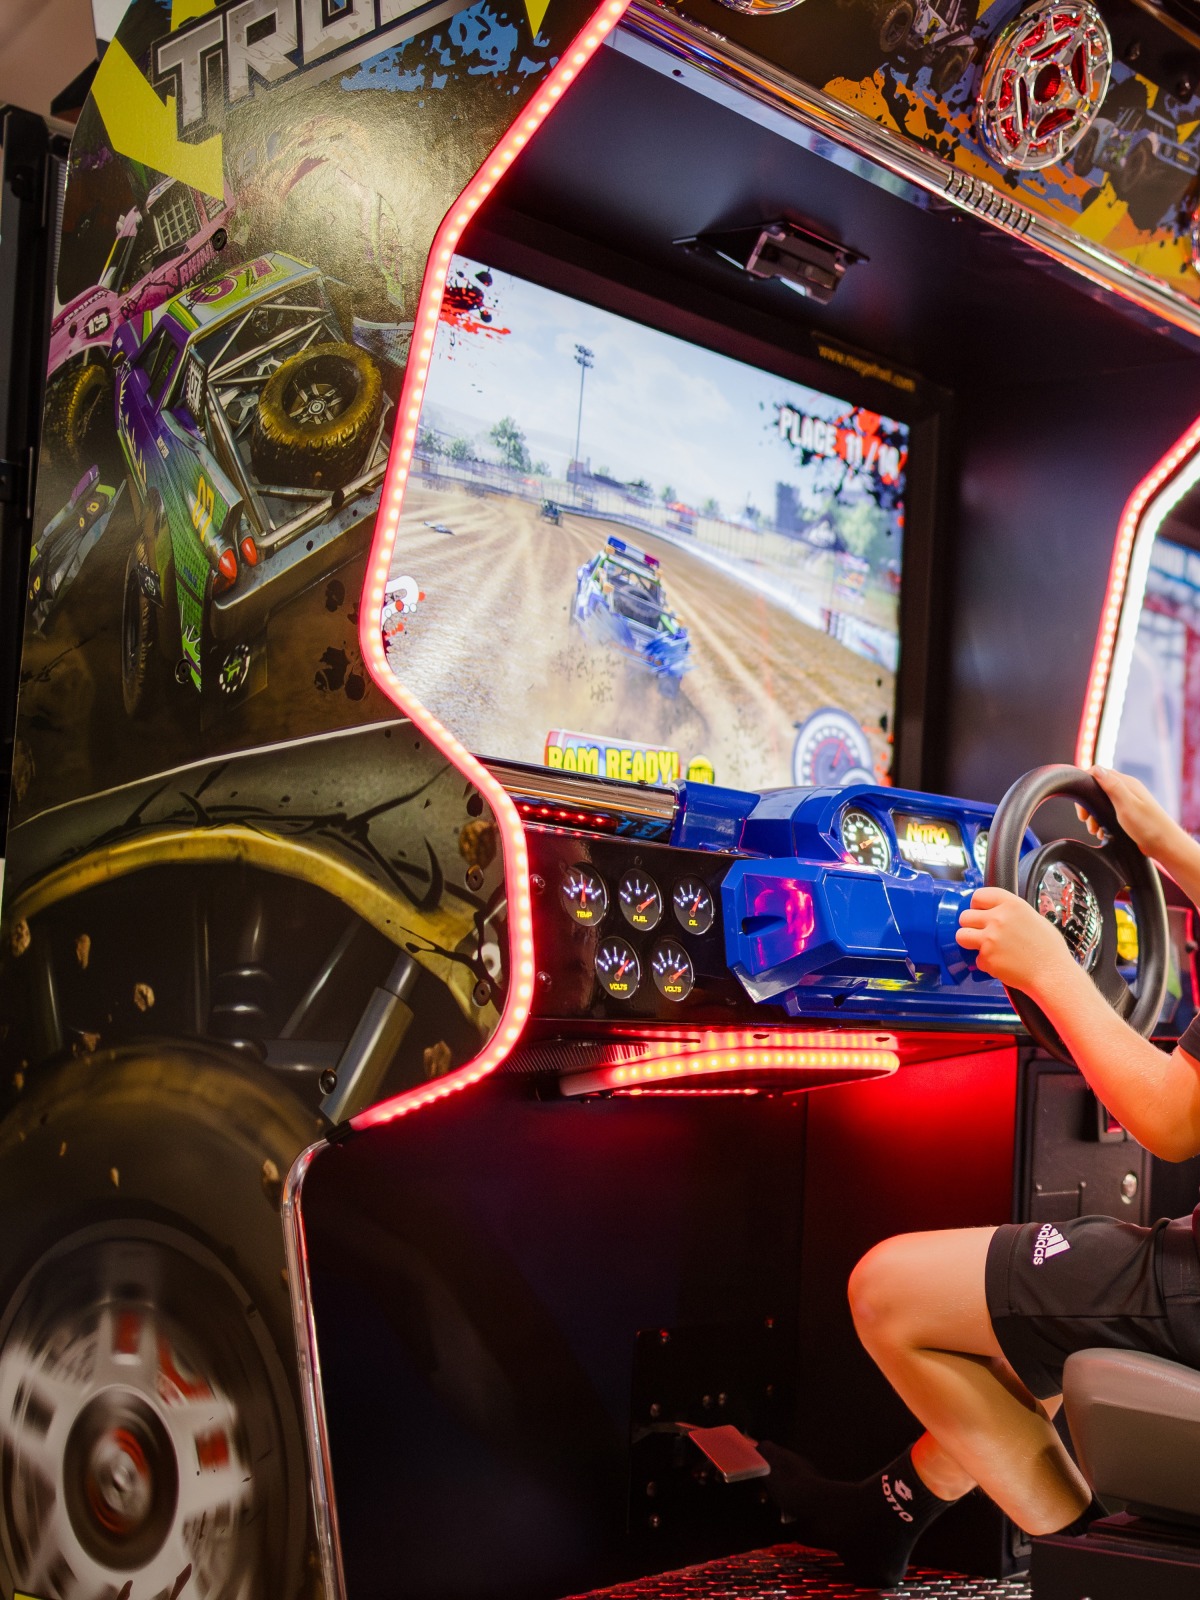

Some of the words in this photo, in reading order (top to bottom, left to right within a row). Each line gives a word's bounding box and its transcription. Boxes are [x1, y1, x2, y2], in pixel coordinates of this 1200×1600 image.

[780, 406, 837, 457] PLACE
[605, 748, 679, 785] READY!
[906, 822, 950, 847] NITRO
[576, 910, 593, 919] TEMP
[632, 915, 648, 923] FUEL
[609, 983, 628, 991] VOLTS
[664, 985, 682, 993] VOLTS
[1033, 1223, 1052, 1265] adidas
[881, 1474, 914, 1522] LOTTO
